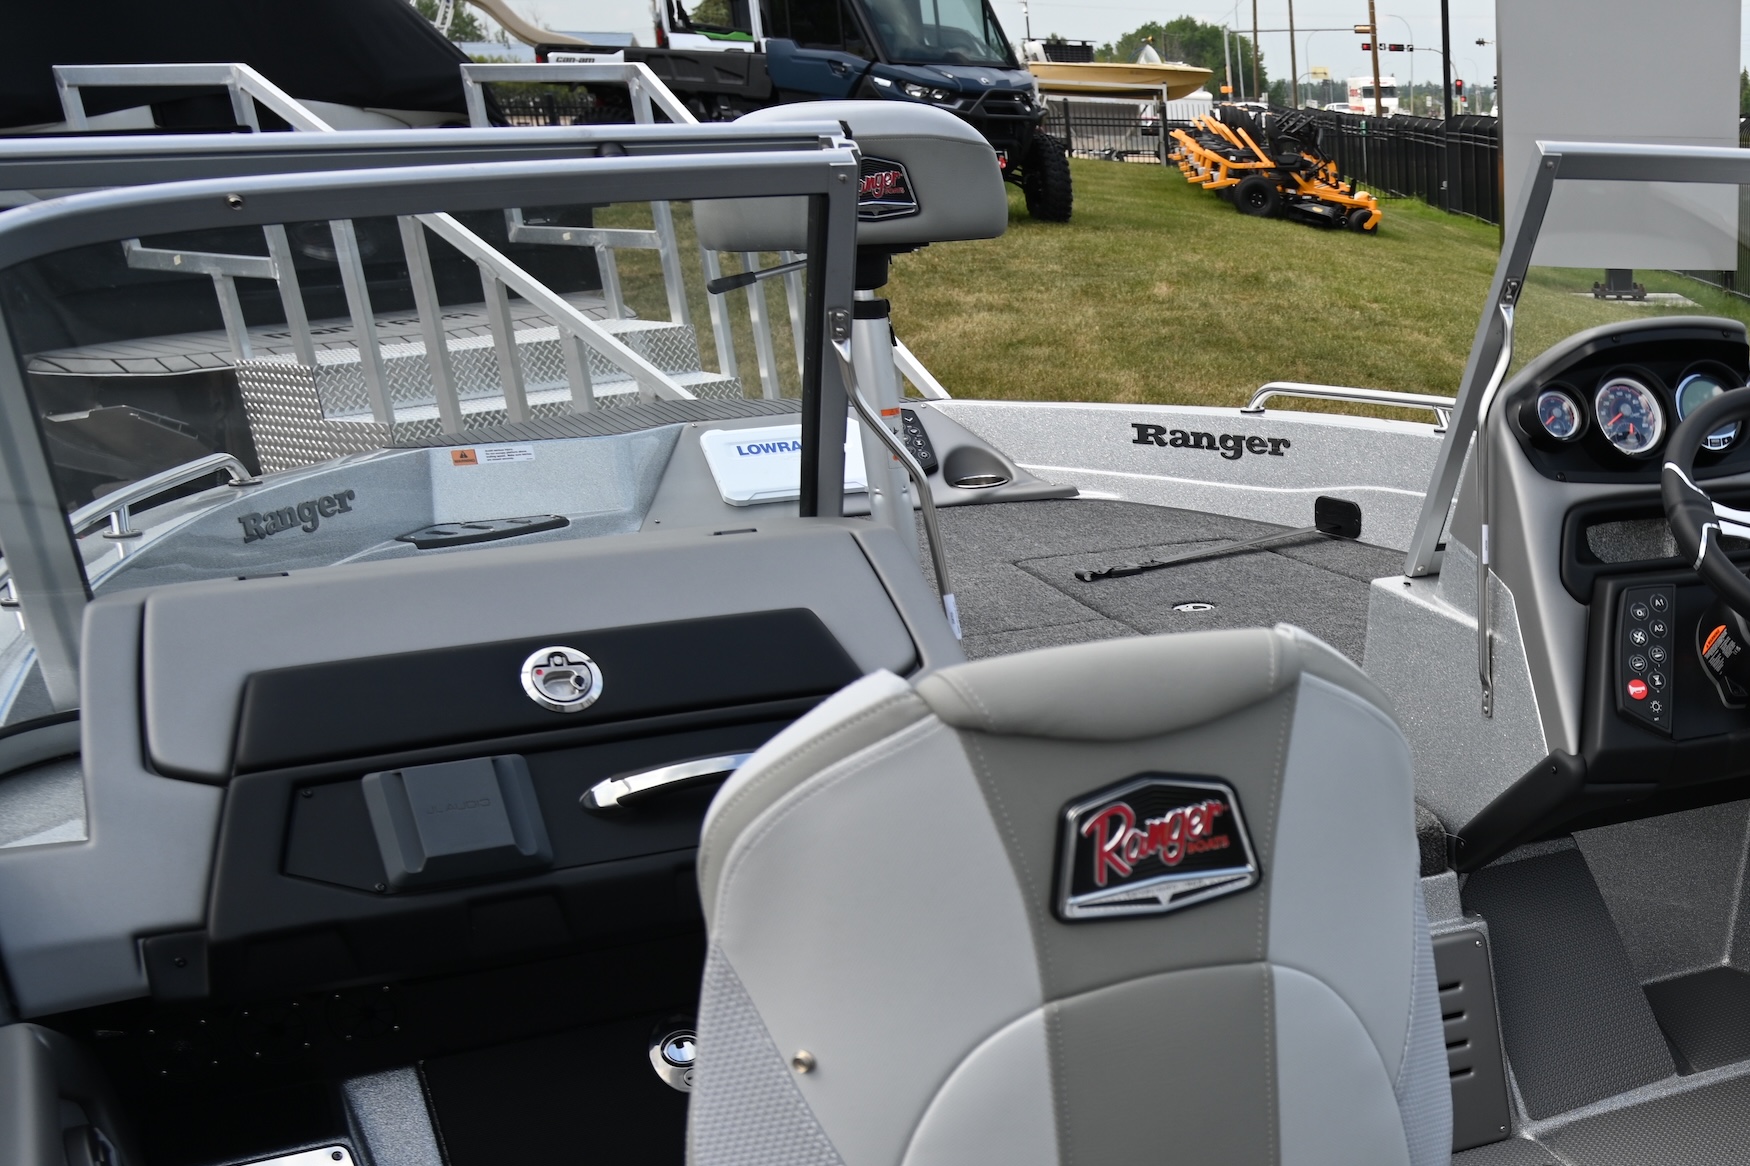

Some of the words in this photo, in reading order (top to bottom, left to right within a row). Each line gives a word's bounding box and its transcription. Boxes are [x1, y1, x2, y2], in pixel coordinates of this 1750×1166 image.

[1131, 422, 1291, 460] Ranger
[237, 489, 356, 544] Ranger
[1654, 624, 1664, 633] A2
[1081, 799, 1225, 886] Ranger
